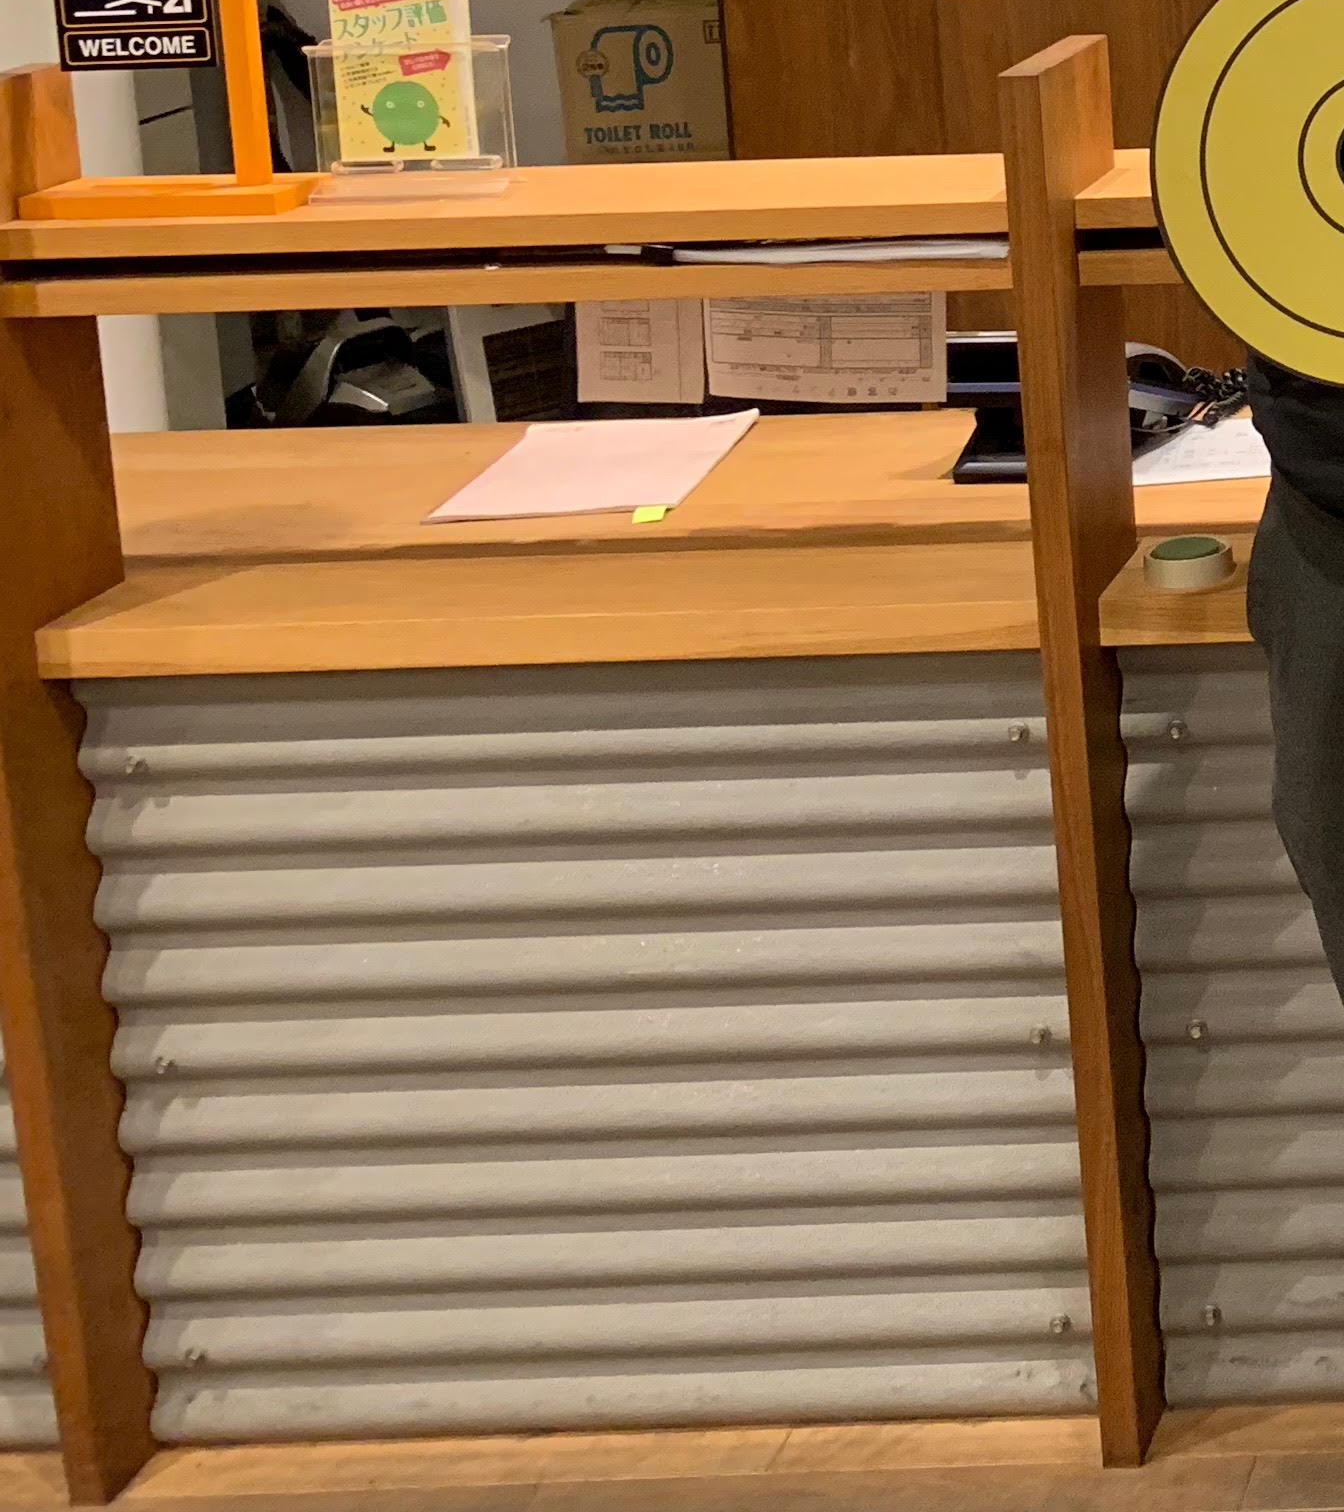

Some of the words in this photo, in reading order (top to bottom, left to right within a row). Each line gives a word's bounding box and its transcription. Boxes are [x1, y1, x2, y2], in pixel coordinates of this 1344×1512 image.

[78, 35, 197, 58] WELCOME
[584, 124, 642, 145] TOILET
[649, 121, 692, 140] ROLL
